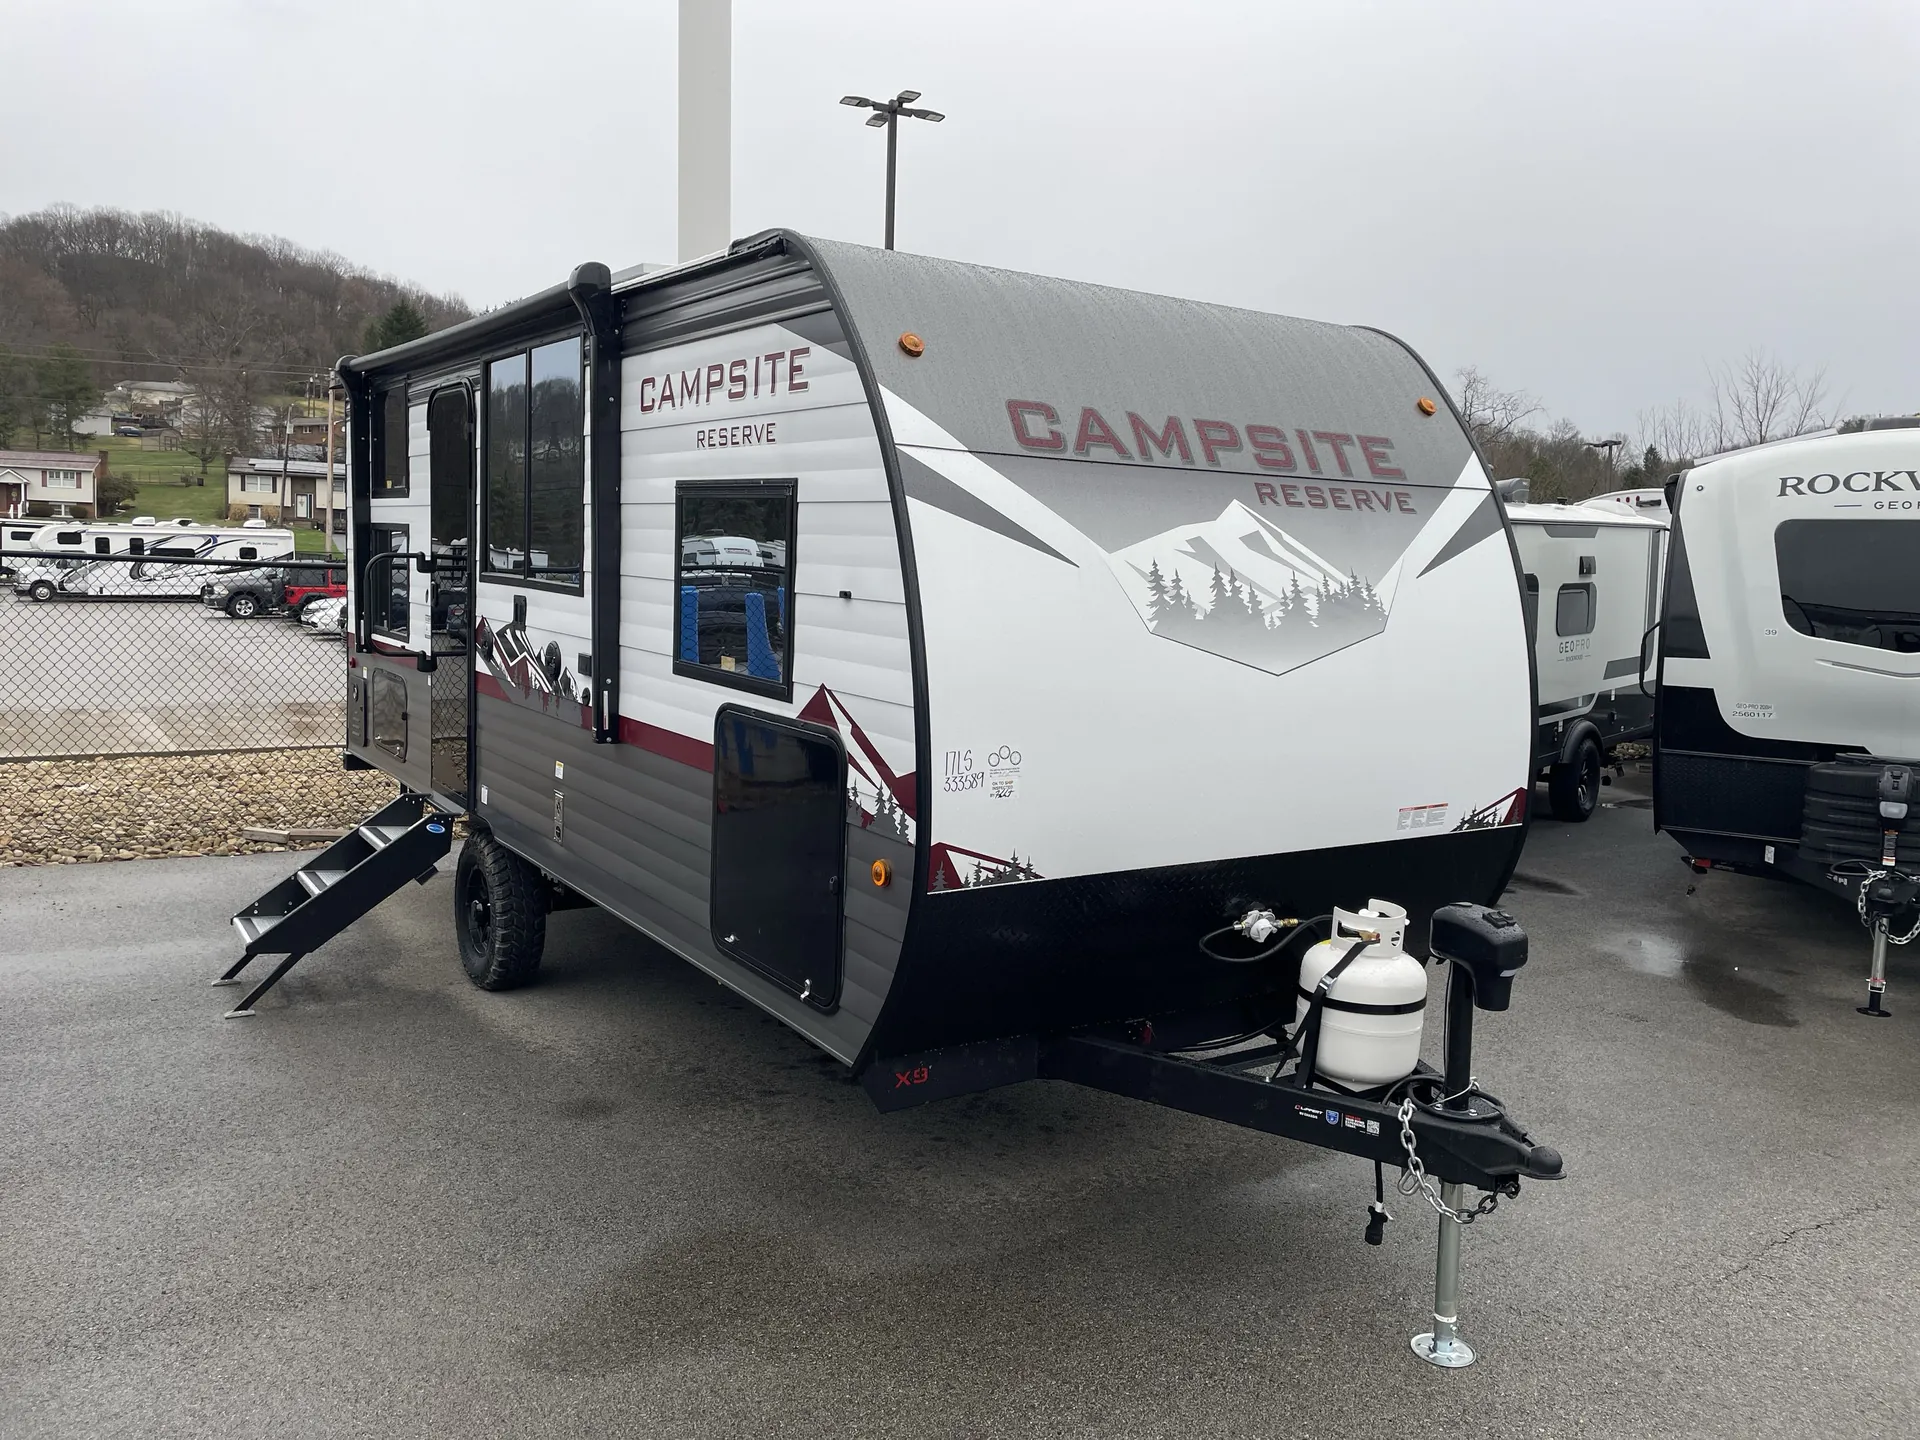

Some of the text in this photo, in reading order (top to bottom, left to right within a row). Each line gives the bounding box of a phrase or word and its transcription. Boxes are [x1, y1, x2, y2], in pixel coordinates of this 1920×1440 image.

[640, 347, 810, 414] CAMPSITE
[696, 422, 777, 449] RESERVE
[1006, 399, 1407, 480] CAMPSITE
[1254, 482, 1417, 514] RESERVE
[1873, 501, 1920, 510] GEO
[1732, 710, 1773, 718] 2560117
[943, 771, 985, 793] 333589
